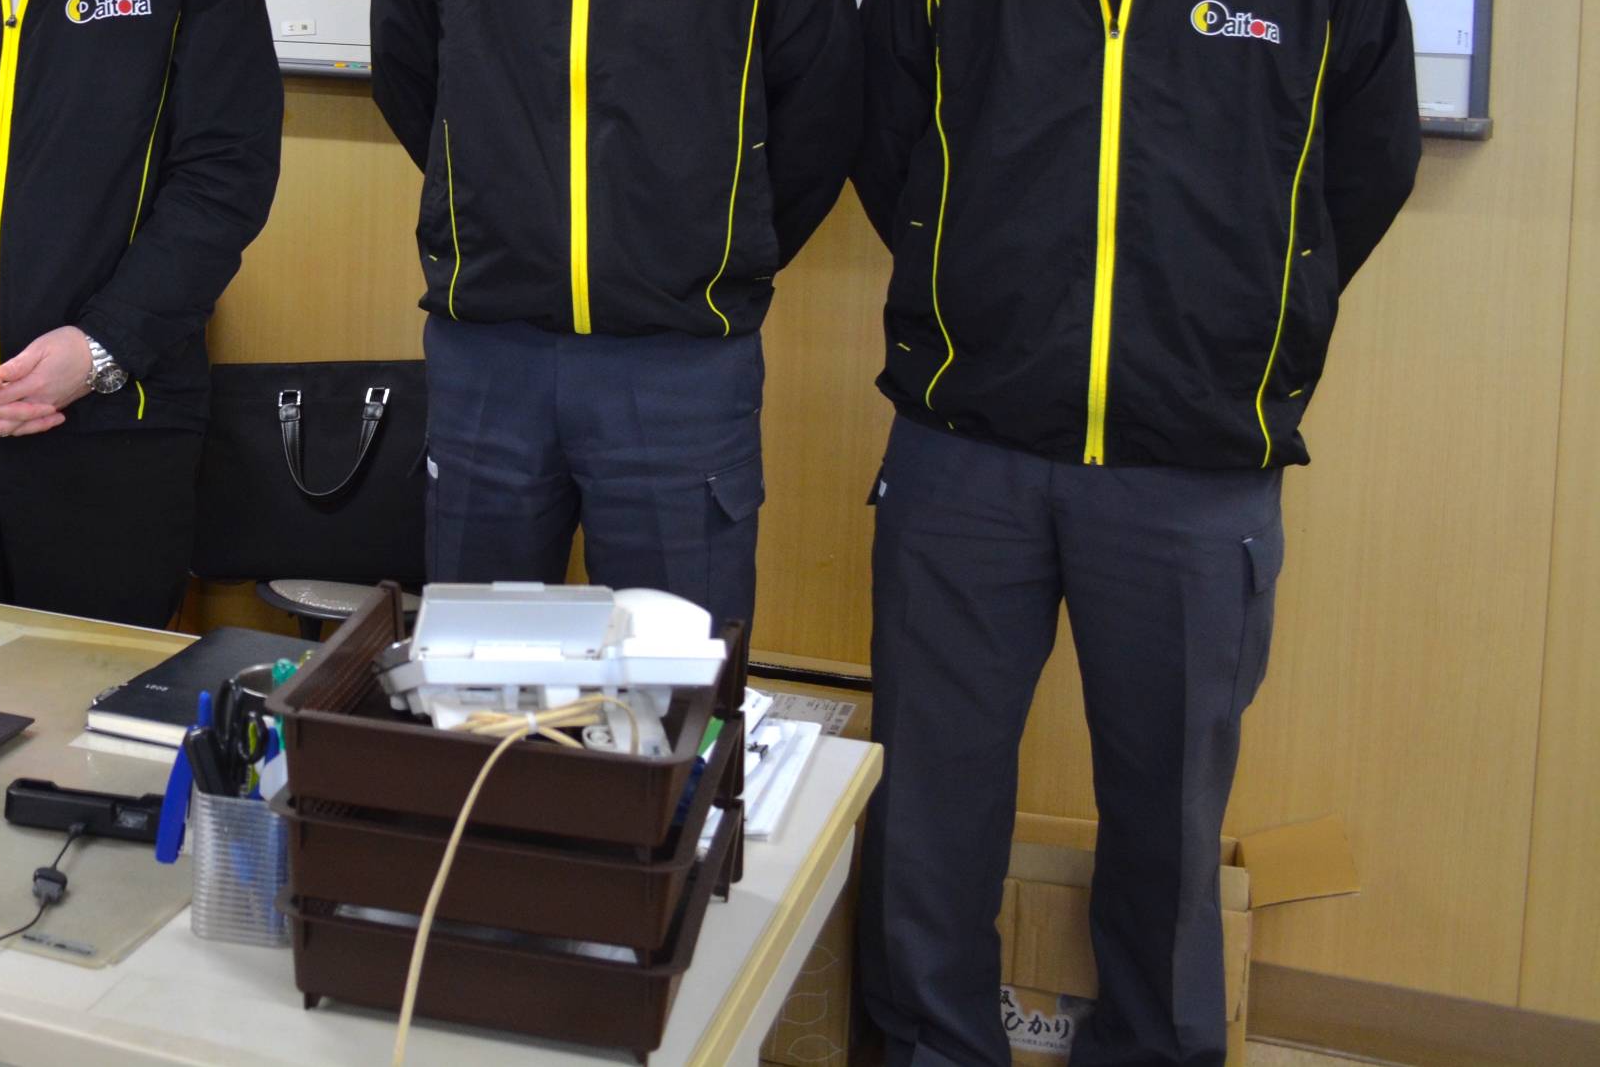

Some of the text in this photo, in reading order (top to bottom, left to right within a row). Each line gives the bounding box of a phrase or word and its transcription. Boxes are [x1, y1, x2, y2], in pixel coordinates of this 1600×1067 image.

[1190, 0, 1280, 44] Daitora
[1004, 1011, 1070, 1040] ひかり
